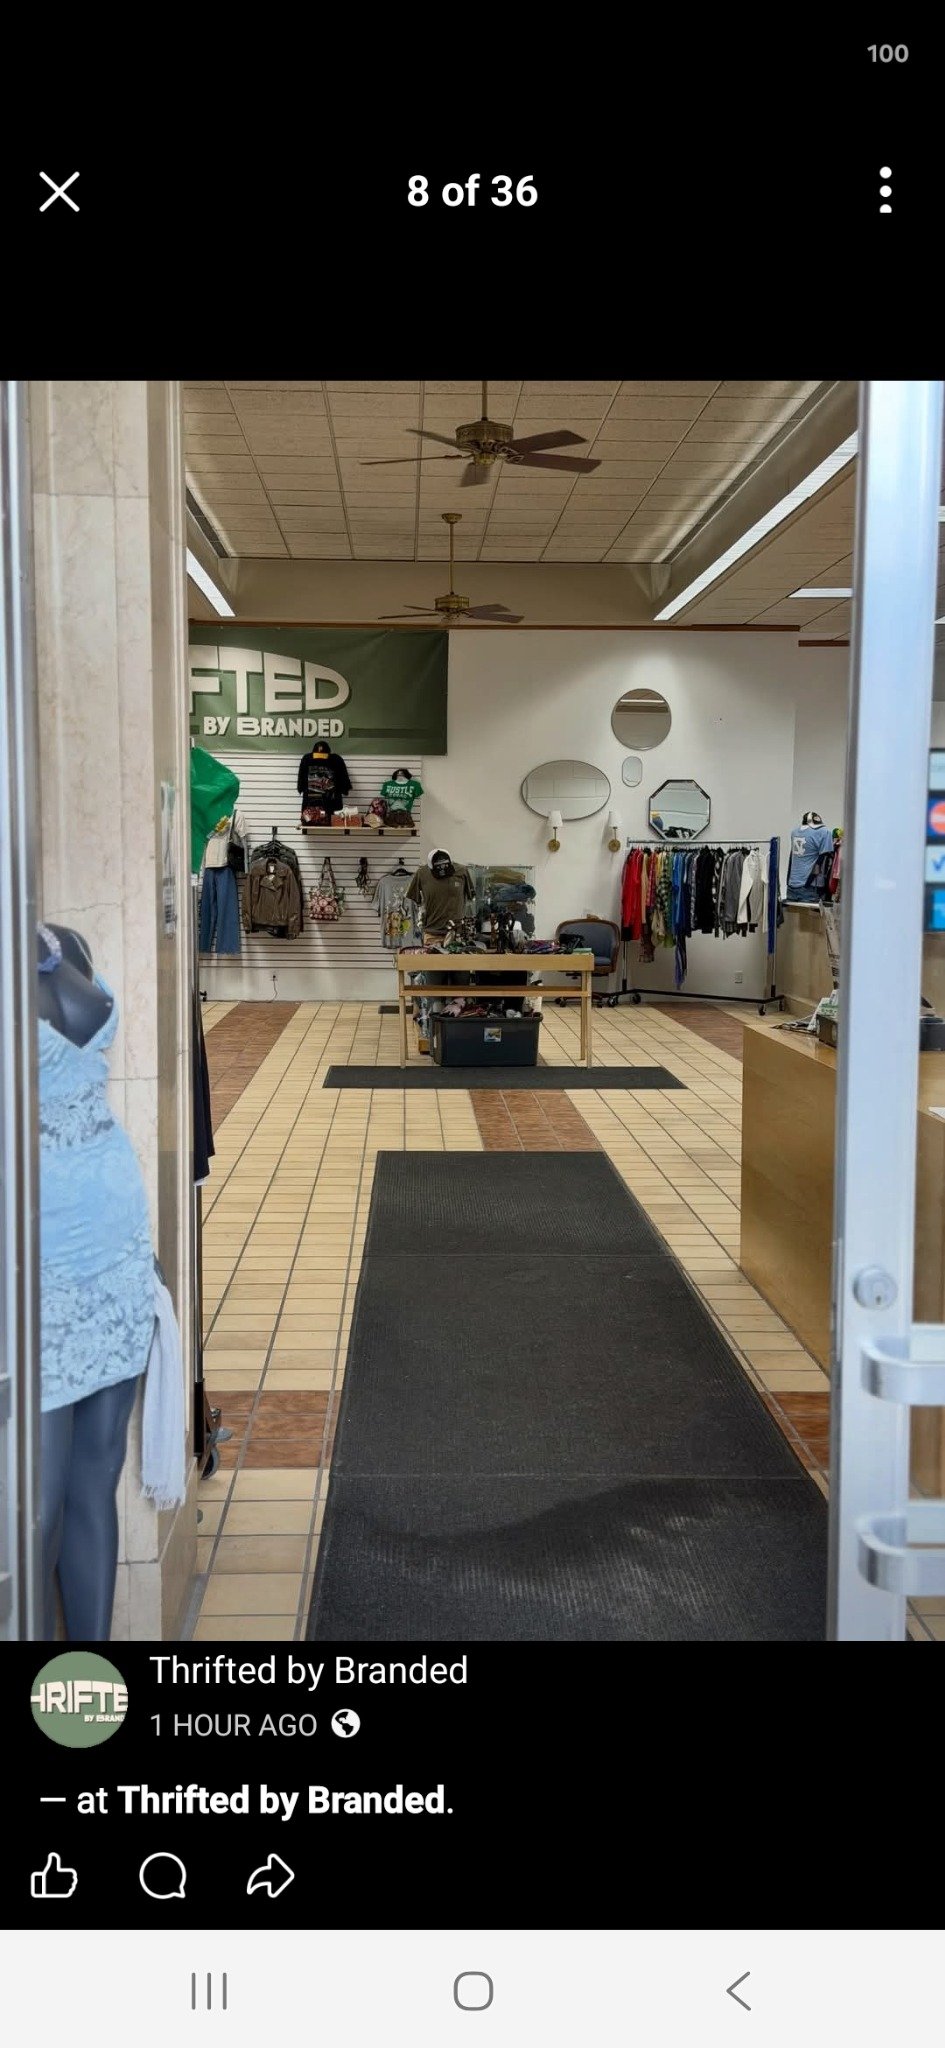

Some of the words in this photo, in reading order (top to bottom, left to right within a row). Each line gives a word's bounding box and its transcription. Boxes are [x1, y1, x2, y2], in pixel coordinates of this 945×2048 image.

[189, 644, 350, 714] FTED
[203, 716, 231, 736] BY
[237, 717, 345, 738] BRANDED
